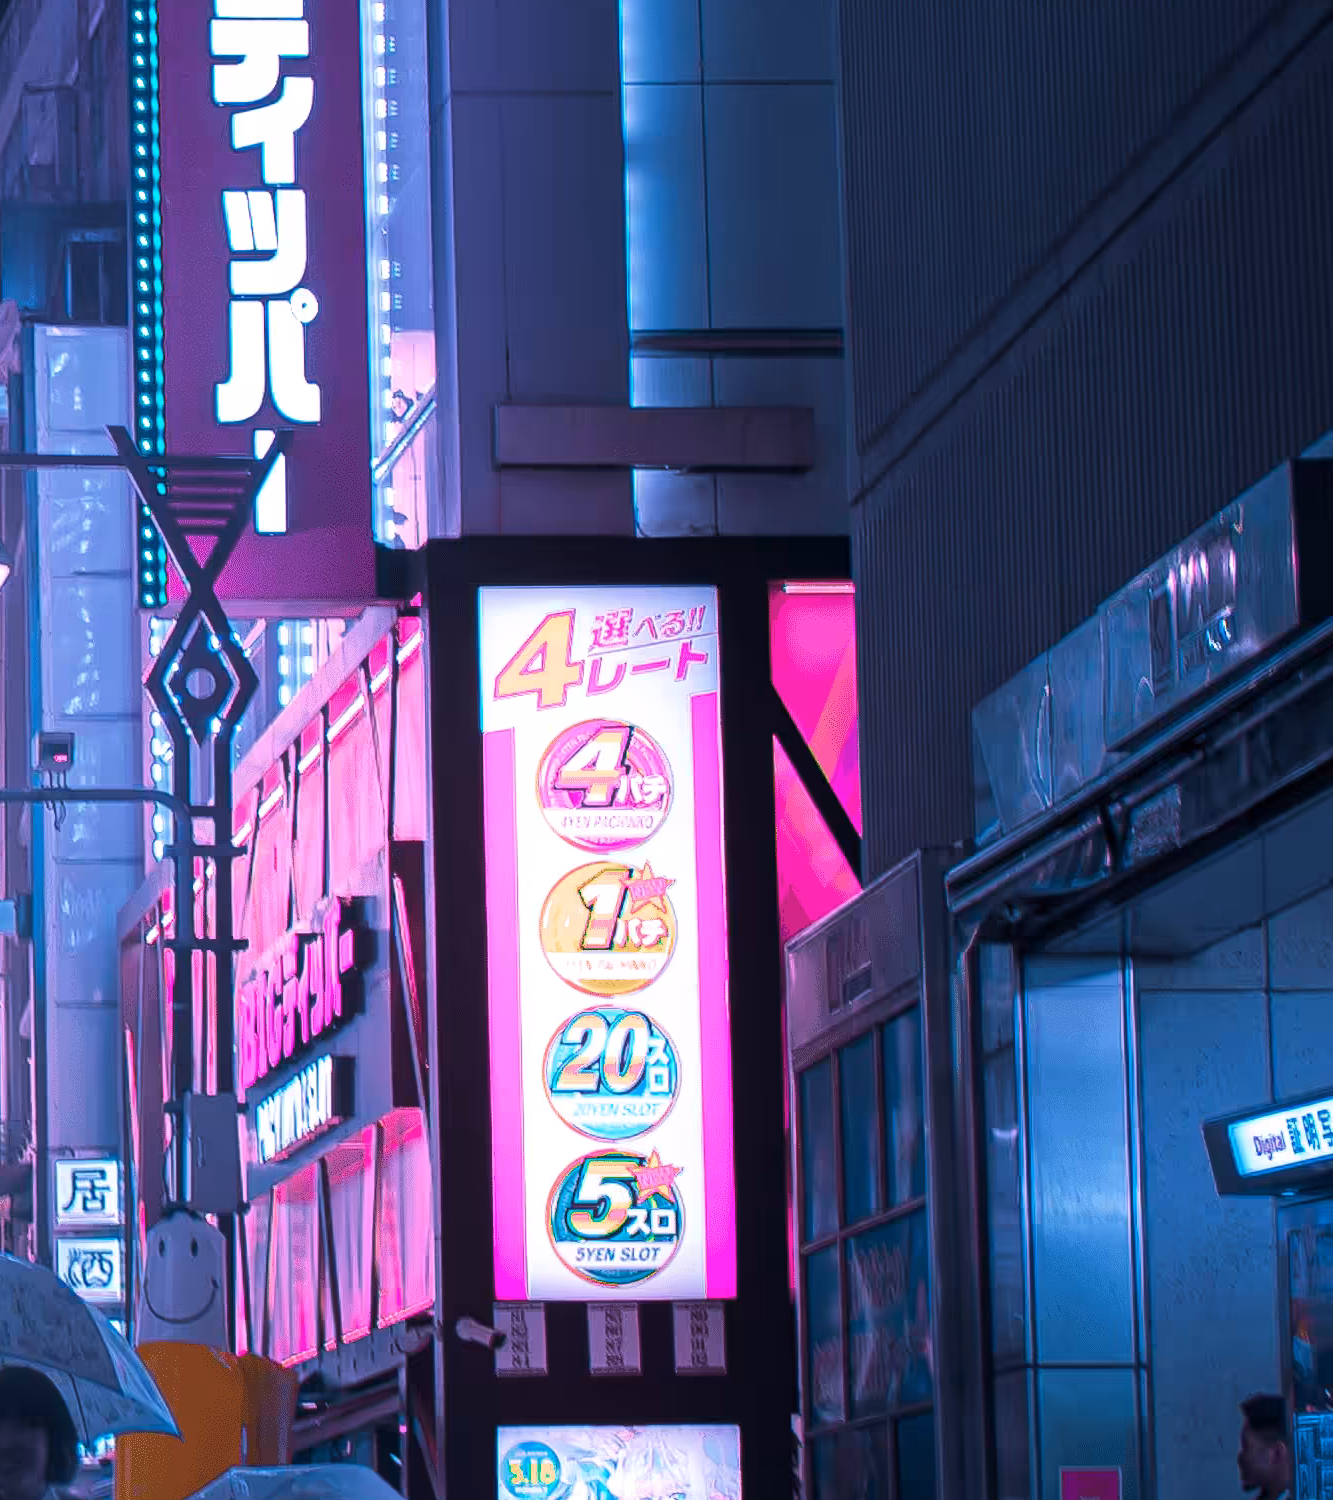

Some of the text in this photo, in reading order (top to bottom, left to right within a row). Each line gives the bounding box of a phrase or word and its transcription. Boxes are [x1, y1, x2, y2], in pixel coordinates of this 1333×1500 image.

[493, 607, 586, 712] 4
[586, 640, 710, 698] レート
[554, 726, 634, 808] 4
[550, 1008, 653, 1096] 20
[565, 1159, 640, 1241] 5
[626, 1206, 677, 1238] スロ
[574, 1245, 662, 1263] 5YEN SLOT
